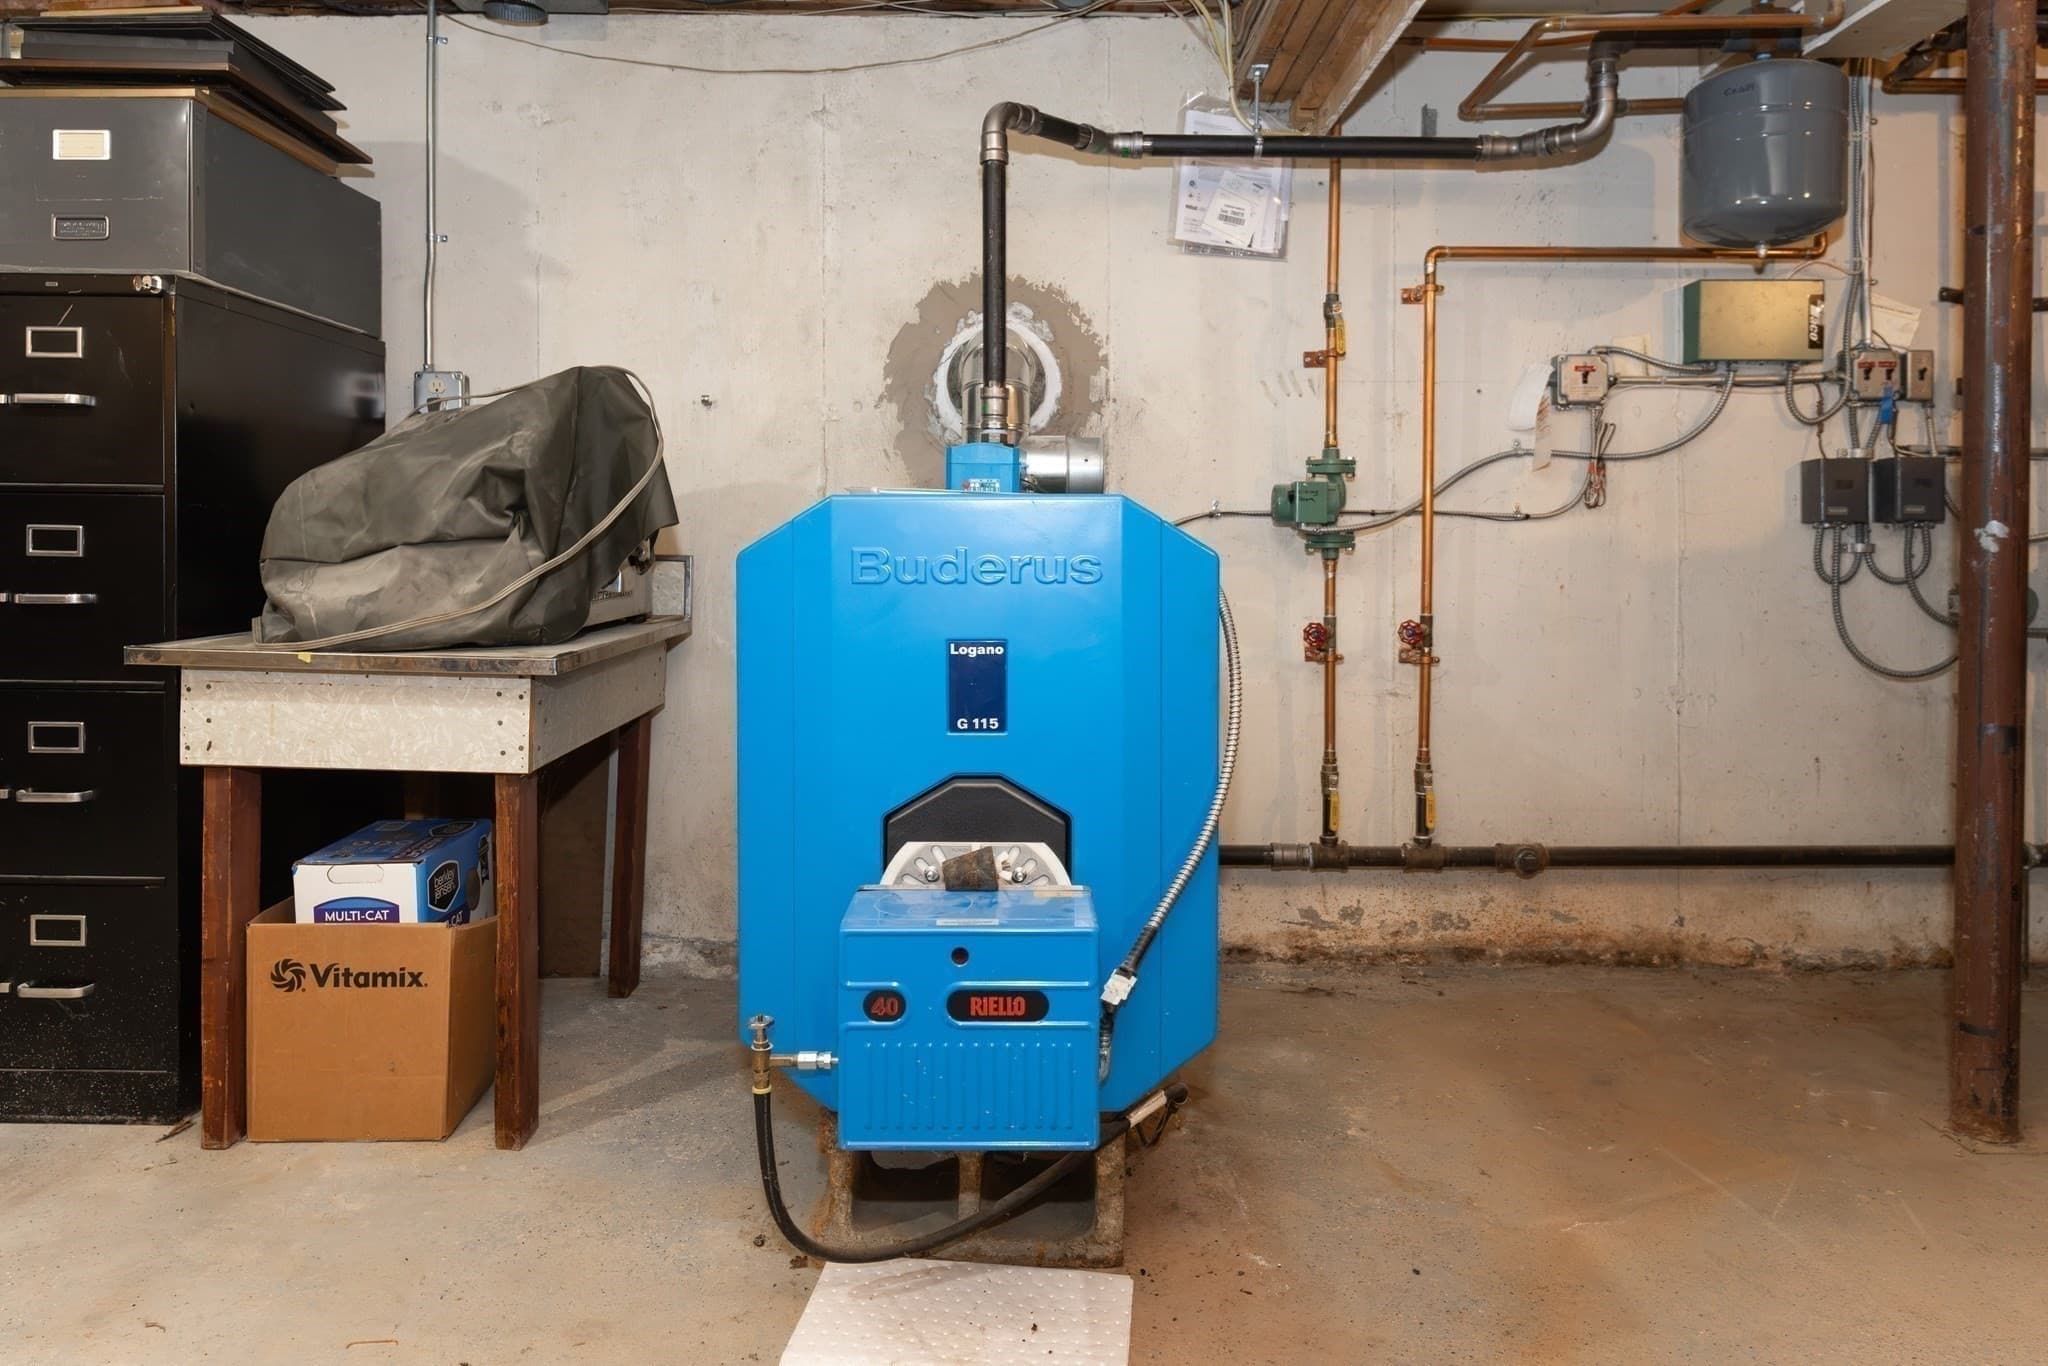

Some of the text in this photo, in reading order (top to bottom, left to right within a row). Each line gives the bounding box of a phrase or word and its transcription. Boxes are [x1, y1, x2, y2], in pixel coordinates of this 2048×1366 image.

[851, 546, 1103, 585] Buderus
[950, 643, 1004, 658] Logano
[957, 718, 999, 729] G 115
[325, 910, 390, 922] MULTI-CAT
[309, 963, 424, 988] Vitamix
[870, 997, 1026, 1016] 40 RIELLO
